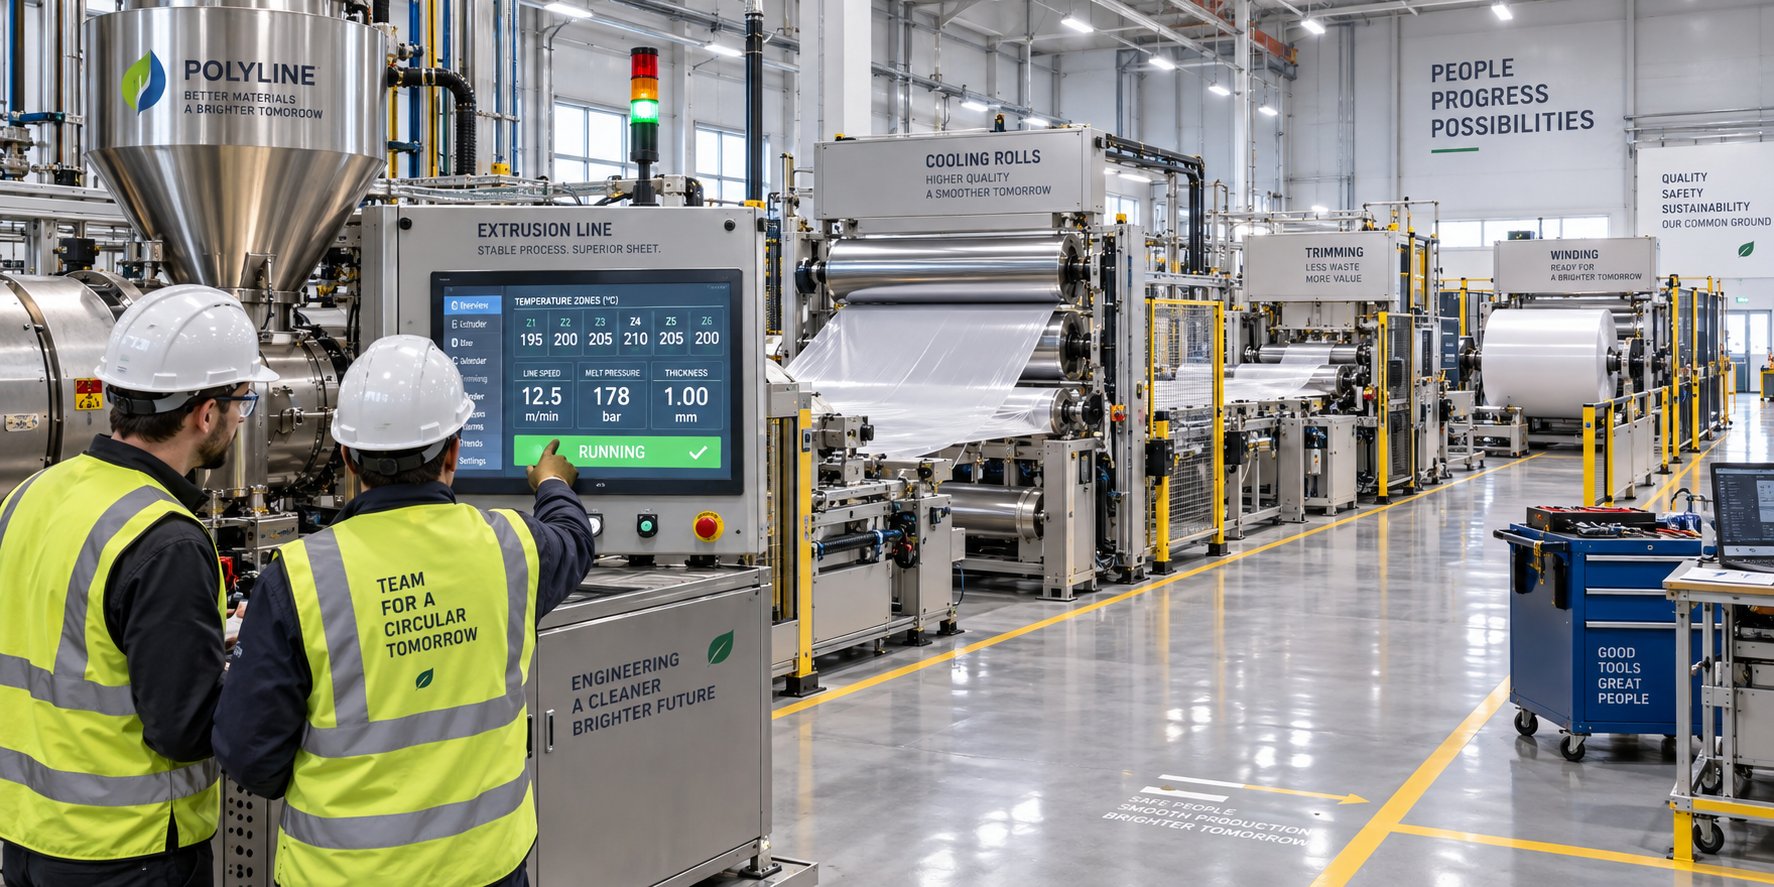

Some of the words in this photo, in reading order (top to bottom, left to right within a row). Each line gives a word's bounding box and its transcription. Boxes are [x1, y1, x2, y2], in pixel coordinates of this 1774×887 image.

[184, 60, 316, 86] POLYLINE
[1431, 58, 1514, 83] PEOPLE
[184, 91, 228, 101] BETTER
[233, 92, 296, 104] MATERIALS
[1431, 84, 1549, 110] PROGRESS
[184, 104, 192, 114] A
[196, 104, 255, 116] BRIGHTER
[1431, 109, 1595, 138] POSSIBILITIES
[925, 151, 989, 168] COOLING
[994, 149, 1041, 166] ROLLS
[925, 174, 963, 185] HIGHER
[966, 172, 1010, 185] QUALITY
[1661, 172, 1708, 184] QUALITY
[926, 190, 933, 199] A
[935, 187, 990, 199] SMOOTHER
[993, 185, 1052, 197] TOMORROW
[1661, 188, 1704, 199] SAFETY
[1661, 201, 1751, 214] SUSTAINABILITY
[1661, 219, 1682, 229] OUR
[1684, 218, 1728, 228] COMMON
[1730, 216, 1772, 227] GROUND
[477, 222, 571, 238] EXTRUSION
[576, 222, 613, 237] LINE
[477, 245, 517, 256] STABLE
[519, 244, 569, 255] PROCESS.
[572, 244, 623, 255] SUPERIOR
[626, 243, 662, 254] SHEET.
[1305, 247, 1364, 258] TRIMMING
[1550, 249, 1599, 260] WINDING
[1305, 263, 1327, 271] LESS
[1329, 262, 1360, 271] WASTE
[1550, 264, 1577, 272] READY
[1579, 263, 1595, 271] FOR
[1305, 275, 1330, 283] MORE
[1333, 274, 1362, 283] VALUE
[1550, 273, 1556, 281] A
[1558, 273, 1596, 281] BRIGHTER
[1597, 272, 1643, 280] TOMORROW
[514, 297, 573, 306] TEMPERATURE
[574, 296, 601, 305] ZONES
[526, 319, 536, 328] Z1
[560, 318, 571, 327] Z2
[594, 318, 606, 327] Z3
[630, 317, 641, 326] Z4
[665, 317, 677, 326] Z5
[701, 316, 713, 326] Z6
[520, 333, 543, 347] 195
[553, 332, 578, 346] 200
[588, 332, 613, 346] 205
[623, 332, 648, 346] 210
[659, 331, 684, 345] 205
[695, 331, 720, 345] 200
[523, 370, 538, 378] LINE
[538, 370, 561, 378] SPEED
[585, 369, 603, 378] MELT
[604, 369, 641, 378] PRESSURE
[664, 369, 709, 378] THICKNESS
[522, 386, 562, 406] 12.5
[593, 386, 630, 406] 178
[664, 386, 709, 406] 1.00
[525, 411, 559, 423] m/min
[602, 411, 621, 423] bar
[675, 413, 698, 423] mm
[578, 445, 646, 459] RUNNING
[376, 571, 425, 594] TEAM
[381, 595, 417, 616] FOR
[423, 592, 436, 608] A
[384, 607, 467, 637] CIRCULAR
[386, 626, 478, 658] TOMORROW
[1598, 646, 1635, 659] GOOD
[571, 652, 680, 692] ENGINEERING
[1598, 662, 1641, 674] TOOLS
[1598, 677, 1642, 690] GREAT
[572, 698, 584, 715] A
[588, 678, 662, 710] CLEANER
[1598, 693, 1650, 705] PEOPLE
[572, 702, 652, 737] BRIGHTER
[657, 685, 716, 715] FUTURE
[1128, 795, 1171, 808] SAFE
[1172, 802, 1238, 817] PEOPLE
[1101, 811, 1196, 831] BRIGHTER
[1200, 824, 1312, 847] TOMORROW
[1194, 813, 1313, 837] PRODUCTION
